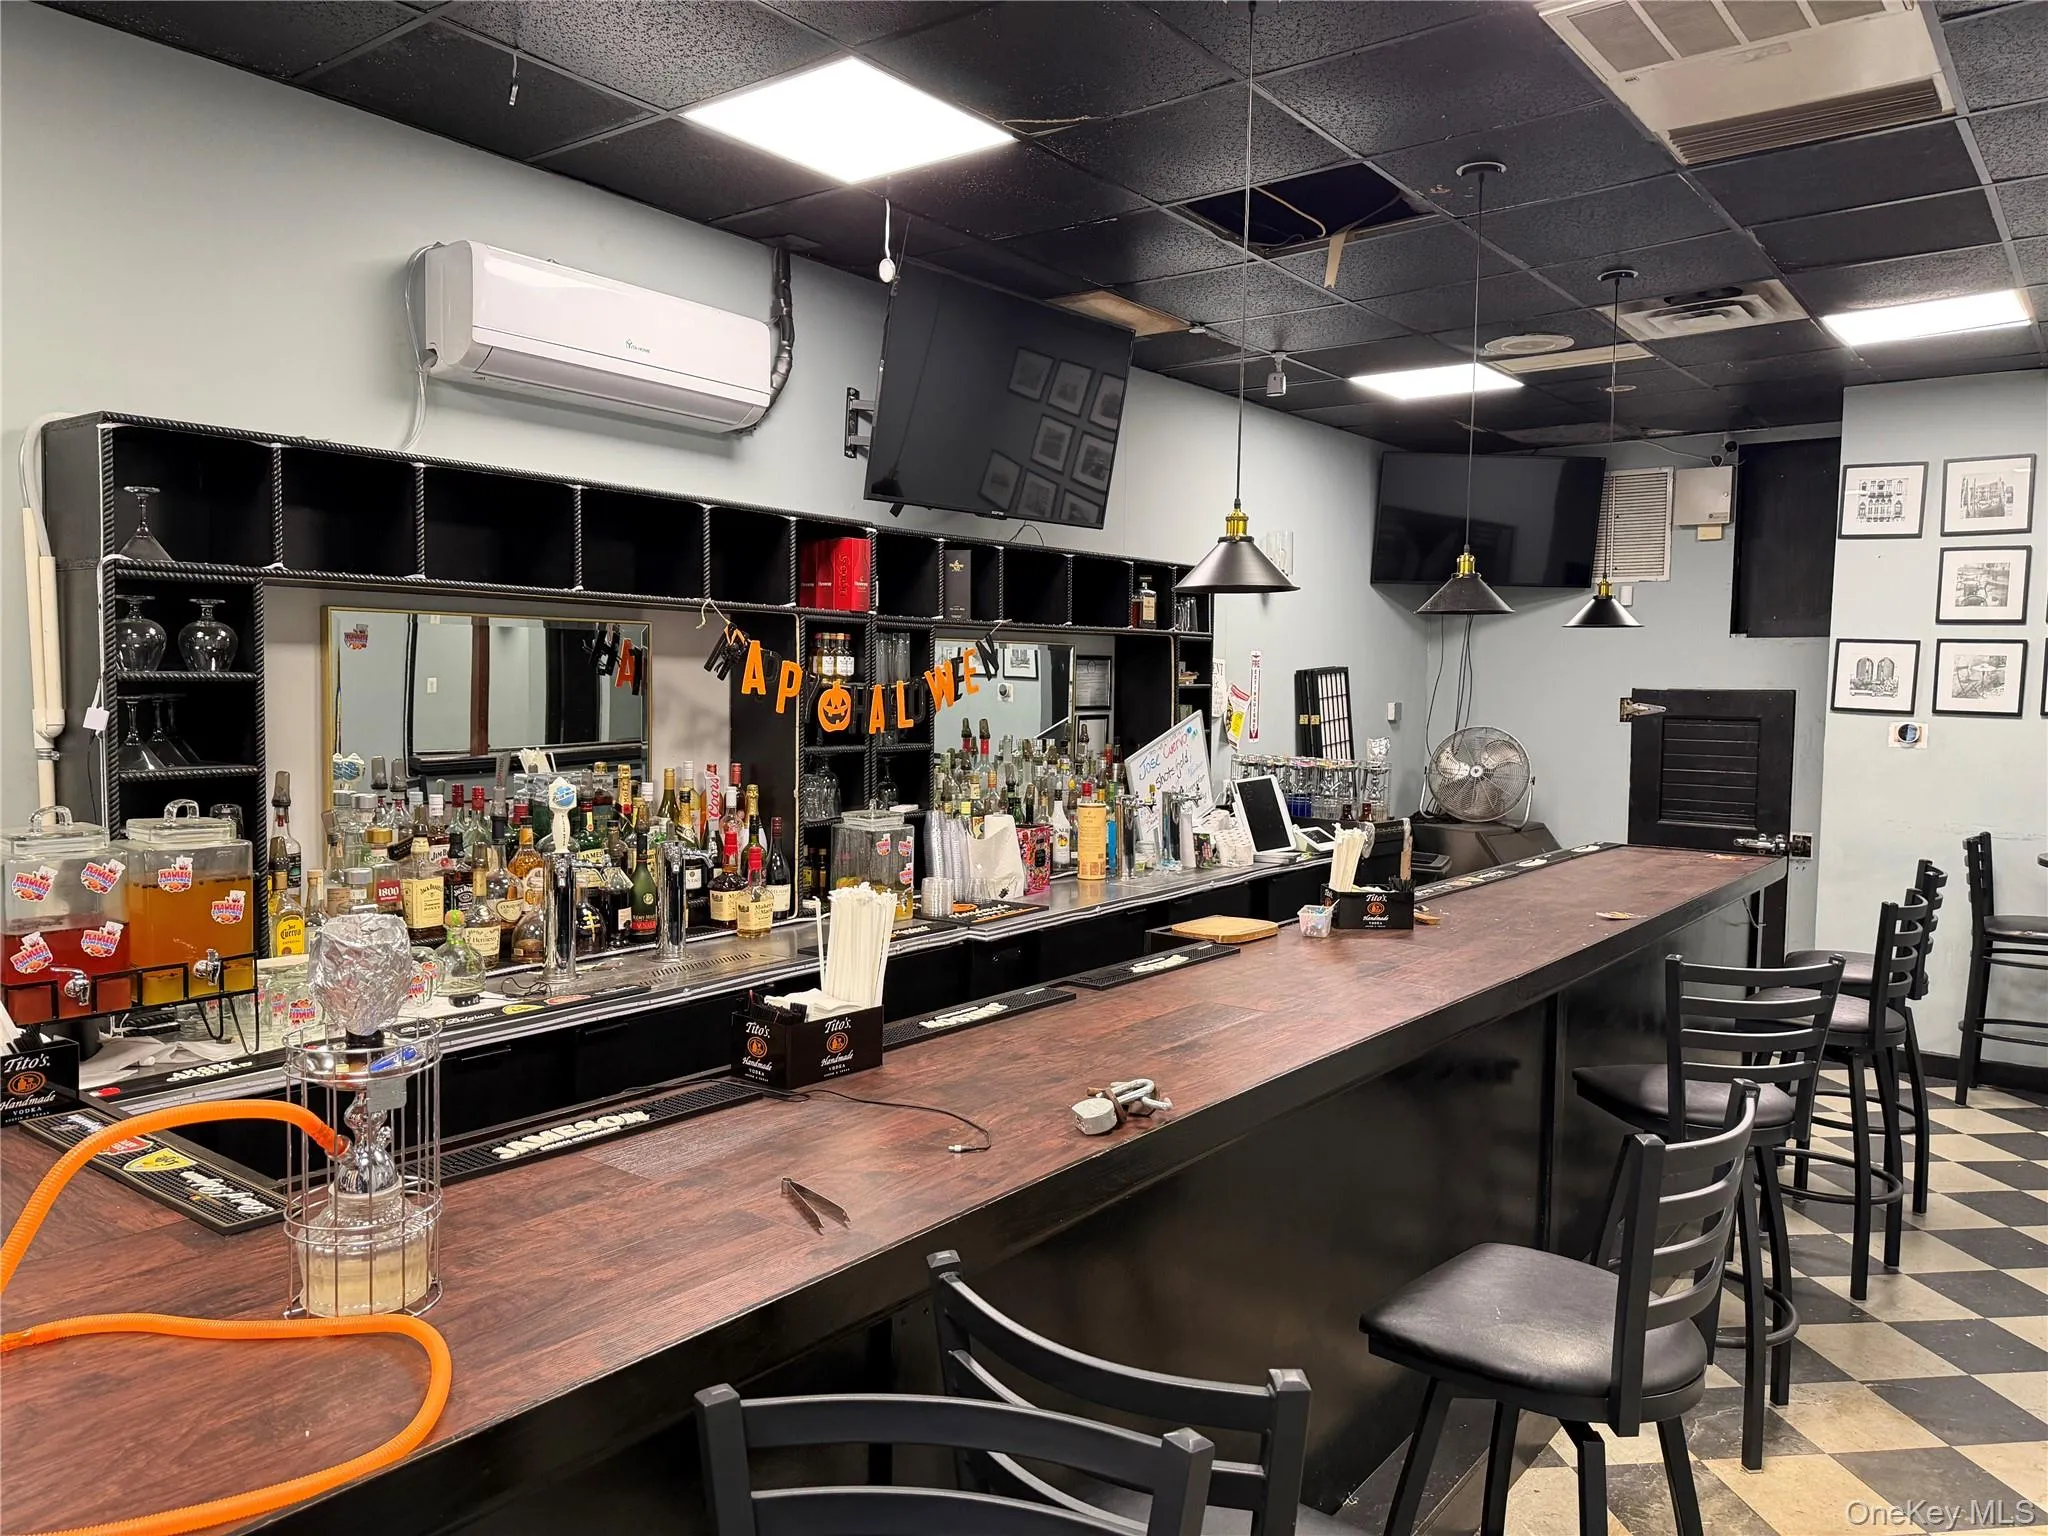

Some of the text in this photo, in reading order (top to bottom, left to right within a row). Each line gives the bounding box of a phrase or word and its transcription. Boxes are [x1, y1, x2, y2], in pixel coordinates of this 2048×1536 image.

[709, 778, 720, 818] Coors
[582, 851, 603, 860] JAMES
[378, 886, 400, 897] 1800
[280, 928, 302, 940] Cuervo
[742, 1056, 773, 1071] Handmade
[820, 1048, 854, 1067] Handmade
[0, 1090, 56, 1112] Handmade
[12, 1106, 43, 1116] VODKA
[492, 1110, 650, 1160] JAMESON
